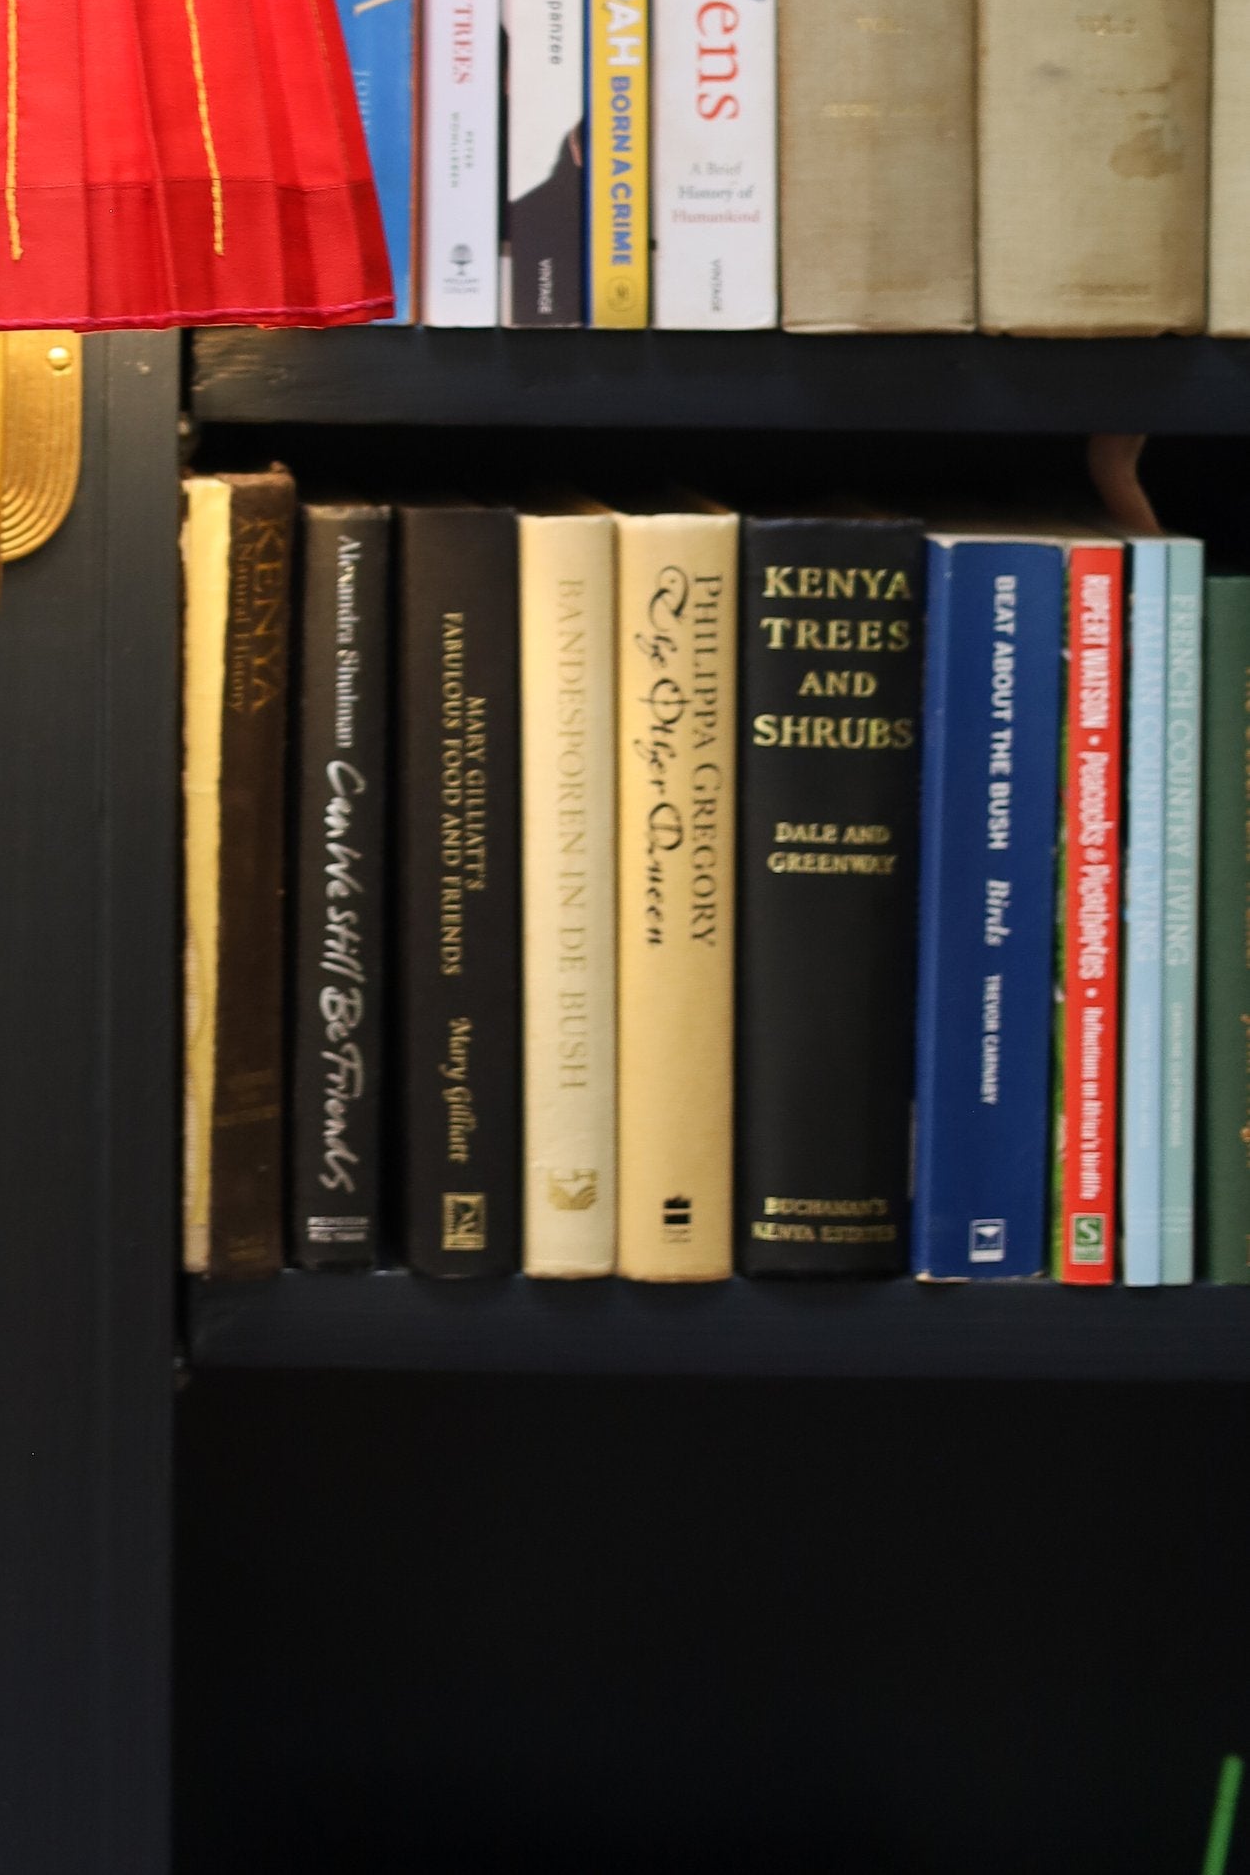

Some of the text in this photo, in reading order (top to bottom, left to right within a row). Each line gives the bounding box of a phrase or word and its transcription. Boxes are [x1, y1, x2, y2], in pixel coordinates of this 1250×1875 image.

[454, 6, 474, 85] TREES
[609, 75, 632, 152] BORN
[611, 157, 630, 178] A
[610, 183, 633, 267] CRIME
[709, 258, 722, 312] VINTAGE
[334, 534, 362, 644] Alexandra
[762, 566, 913, 600] KENYA
[993, 575, 1016, 635] BEAT
[761, 618, 911, 652] TREES
[1081, 574, 1110, 730] RUPERT WATSON
[332, 648, 358, 749] Shulman
[798, 671, 878, 697] AND
[991, 640, 1016, 722] ABOUT
[465, 695, 486, 762] MARY
[633, 565, 691, 948] The Other Queen
[690, 574, 725, 948] PHILIPPA GREGORY
[752, 714, 915, 749] SHRUBS
[990, 729, 1011, 776] THE
[324, 760, 367, 838] Can
[440, 612, 464, 977] FABULOUS FOOD AND FRIENDS
[987, 781, 1011, 850] BUSH
[1079, 751, 1110, 845] Peacocks
[557, 578, 588, 1090] BANDESPOREN IN DE BUSH
[767, 851, 897, 875] GREENWAY
[774, 822, 892, 845] DALE AND
[326, 844, 367, 899] We
[983, 878, 1012, 947] Birds
[320, 987, 366, 1041] Be
[981, 974, 1002, 1031] TREVOR
[440, 1018, 473, 1081] Mary
[319, 1043, 366, 1193] Friends
